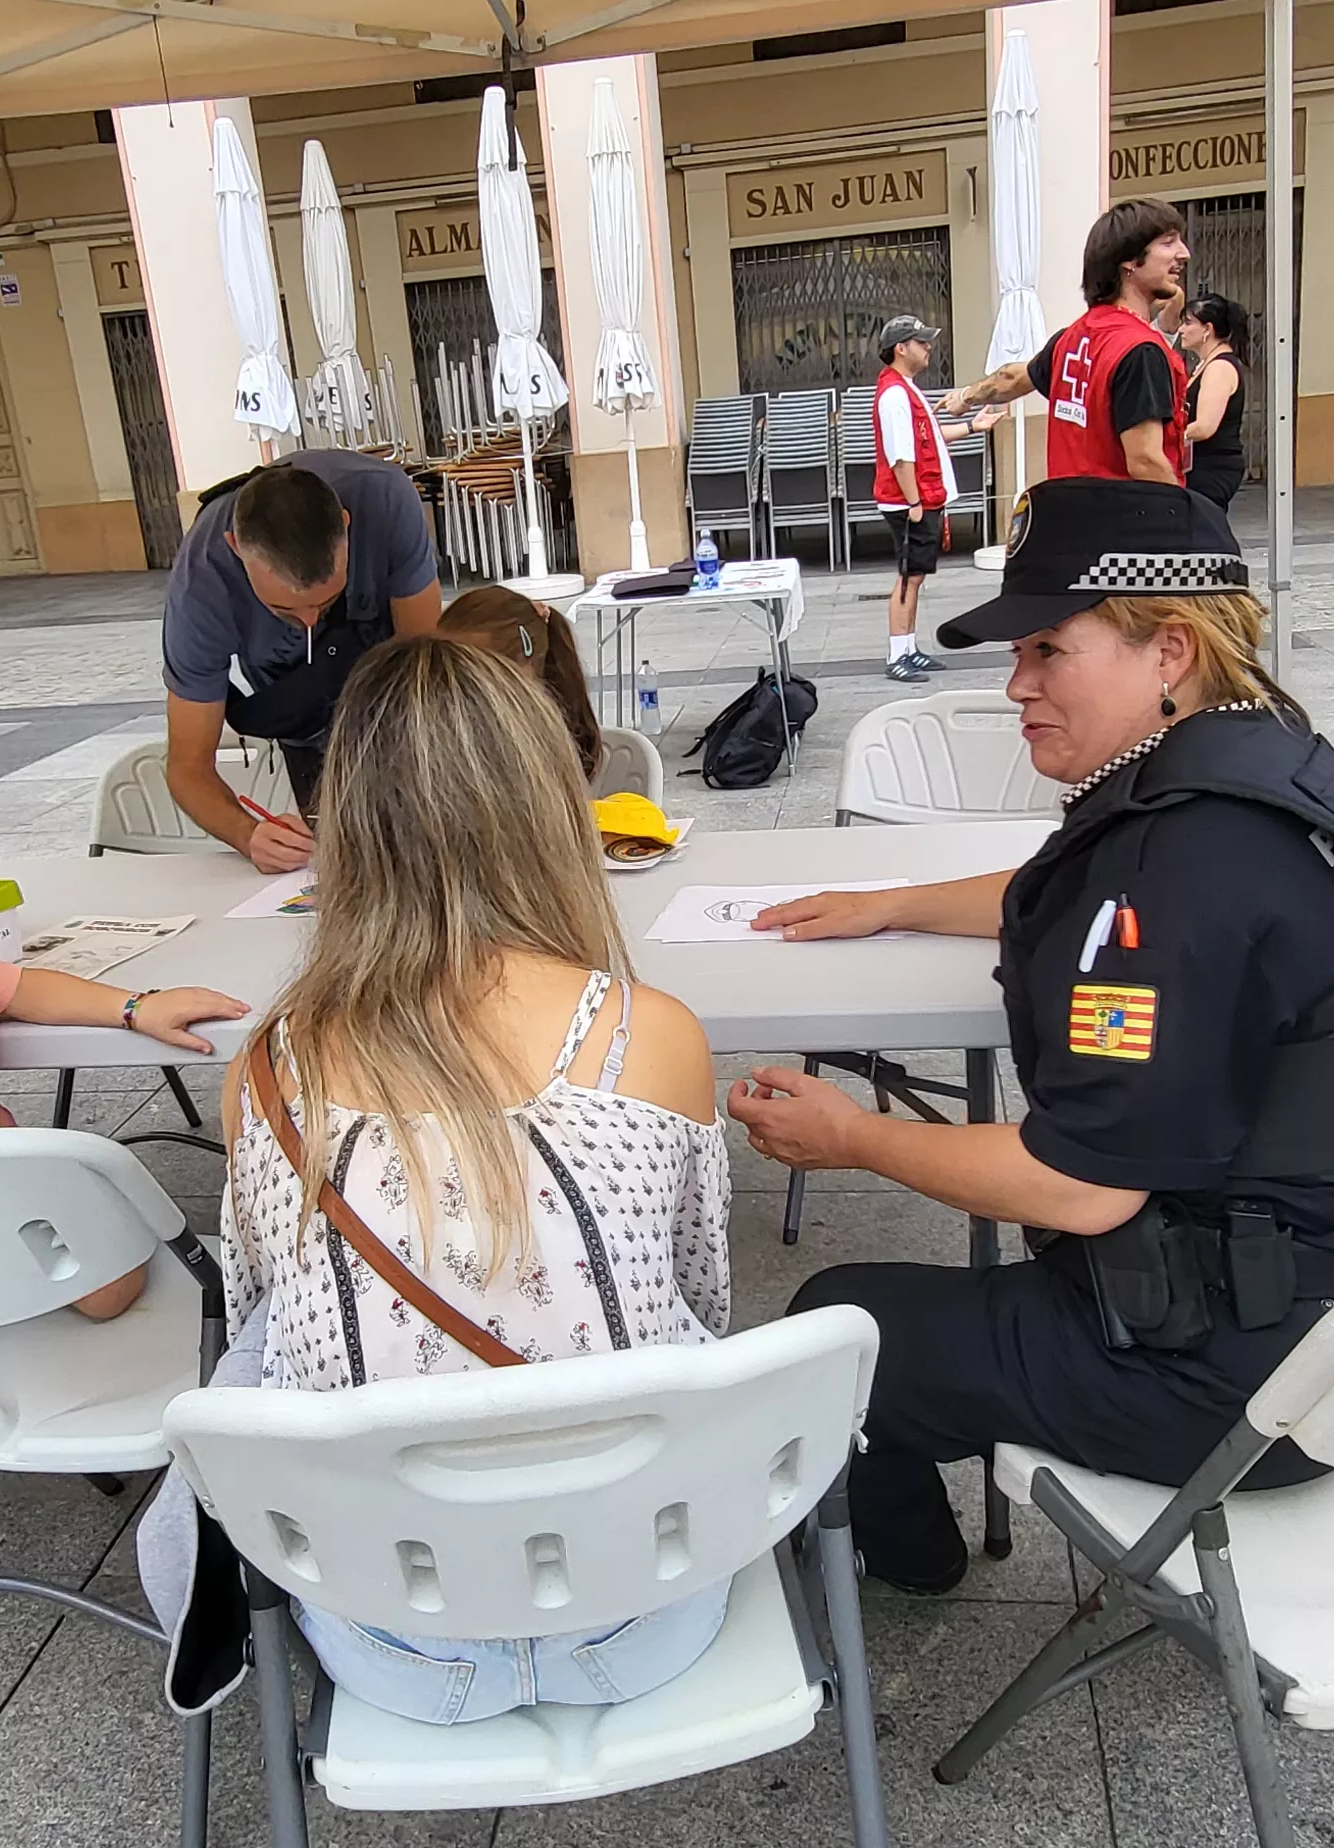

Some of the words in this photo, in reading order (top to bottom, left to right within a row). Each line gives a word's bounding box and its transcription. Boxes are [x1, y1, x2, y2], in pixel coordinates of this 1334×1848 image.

[1109, 131, 1267, 181] ONFECCIONE
[745, 182, 815, 219] SAN
[831, 168, 925, 209] JUAN
